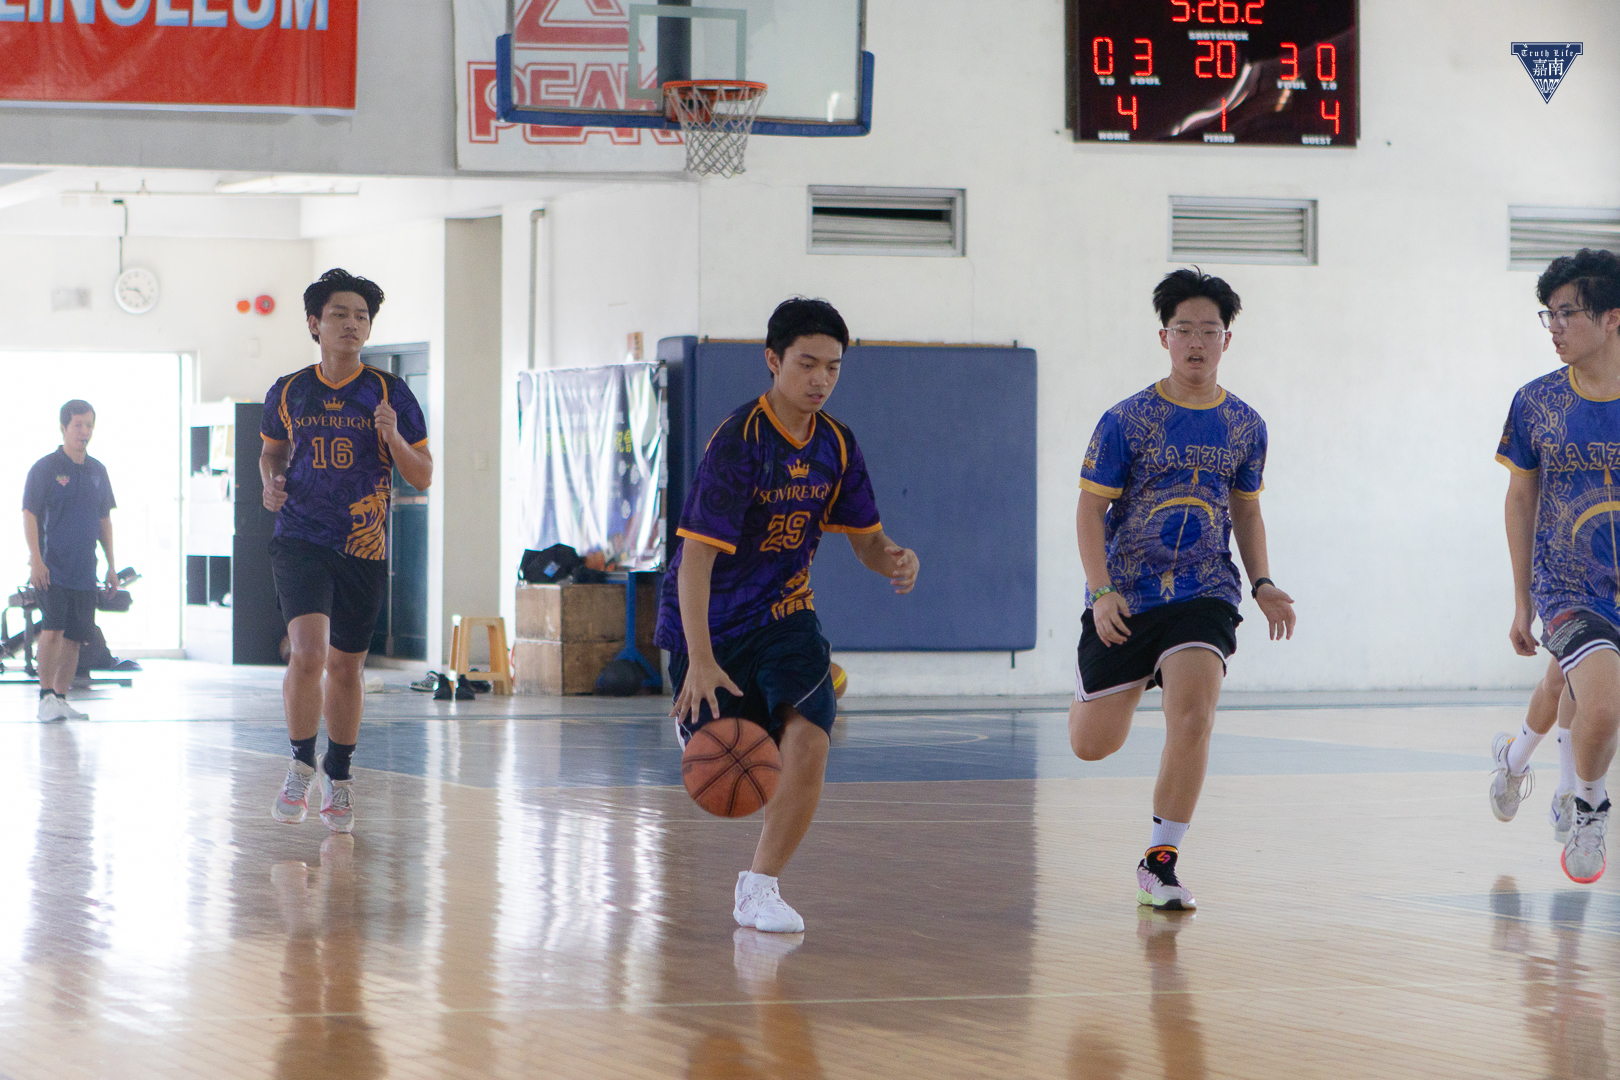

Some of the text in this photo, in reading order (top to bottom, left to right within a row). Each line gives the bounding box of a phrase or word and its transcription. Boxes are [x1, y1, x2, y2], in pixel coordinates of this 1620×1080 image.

[1188, 30, 1249, 41] SHOTCLOCK
[1093, 36, 1153, 76] 0 3
[1195, 40, 1237, 79] 20
[1280, 42, 1336, 81] 3 0
[1129, 75, 1161, 86] FOUL
[1277, 79, 1307, 90] FOUL
[1117, 94, 1138, 130] 4
[1221, 97, 1227, 132] 1
[1321, 99, 1340, 135] 4
[1098, 131, 1131, 141] HOME
[1203, 133, 1236, 143] PERIOD
[1301, 134, 1332, 145] GUEST
[294, 413, 373, 431] SOVEREIGN
[311, 436, 354, 469] 16
[759, 510, 812, 553] 29
